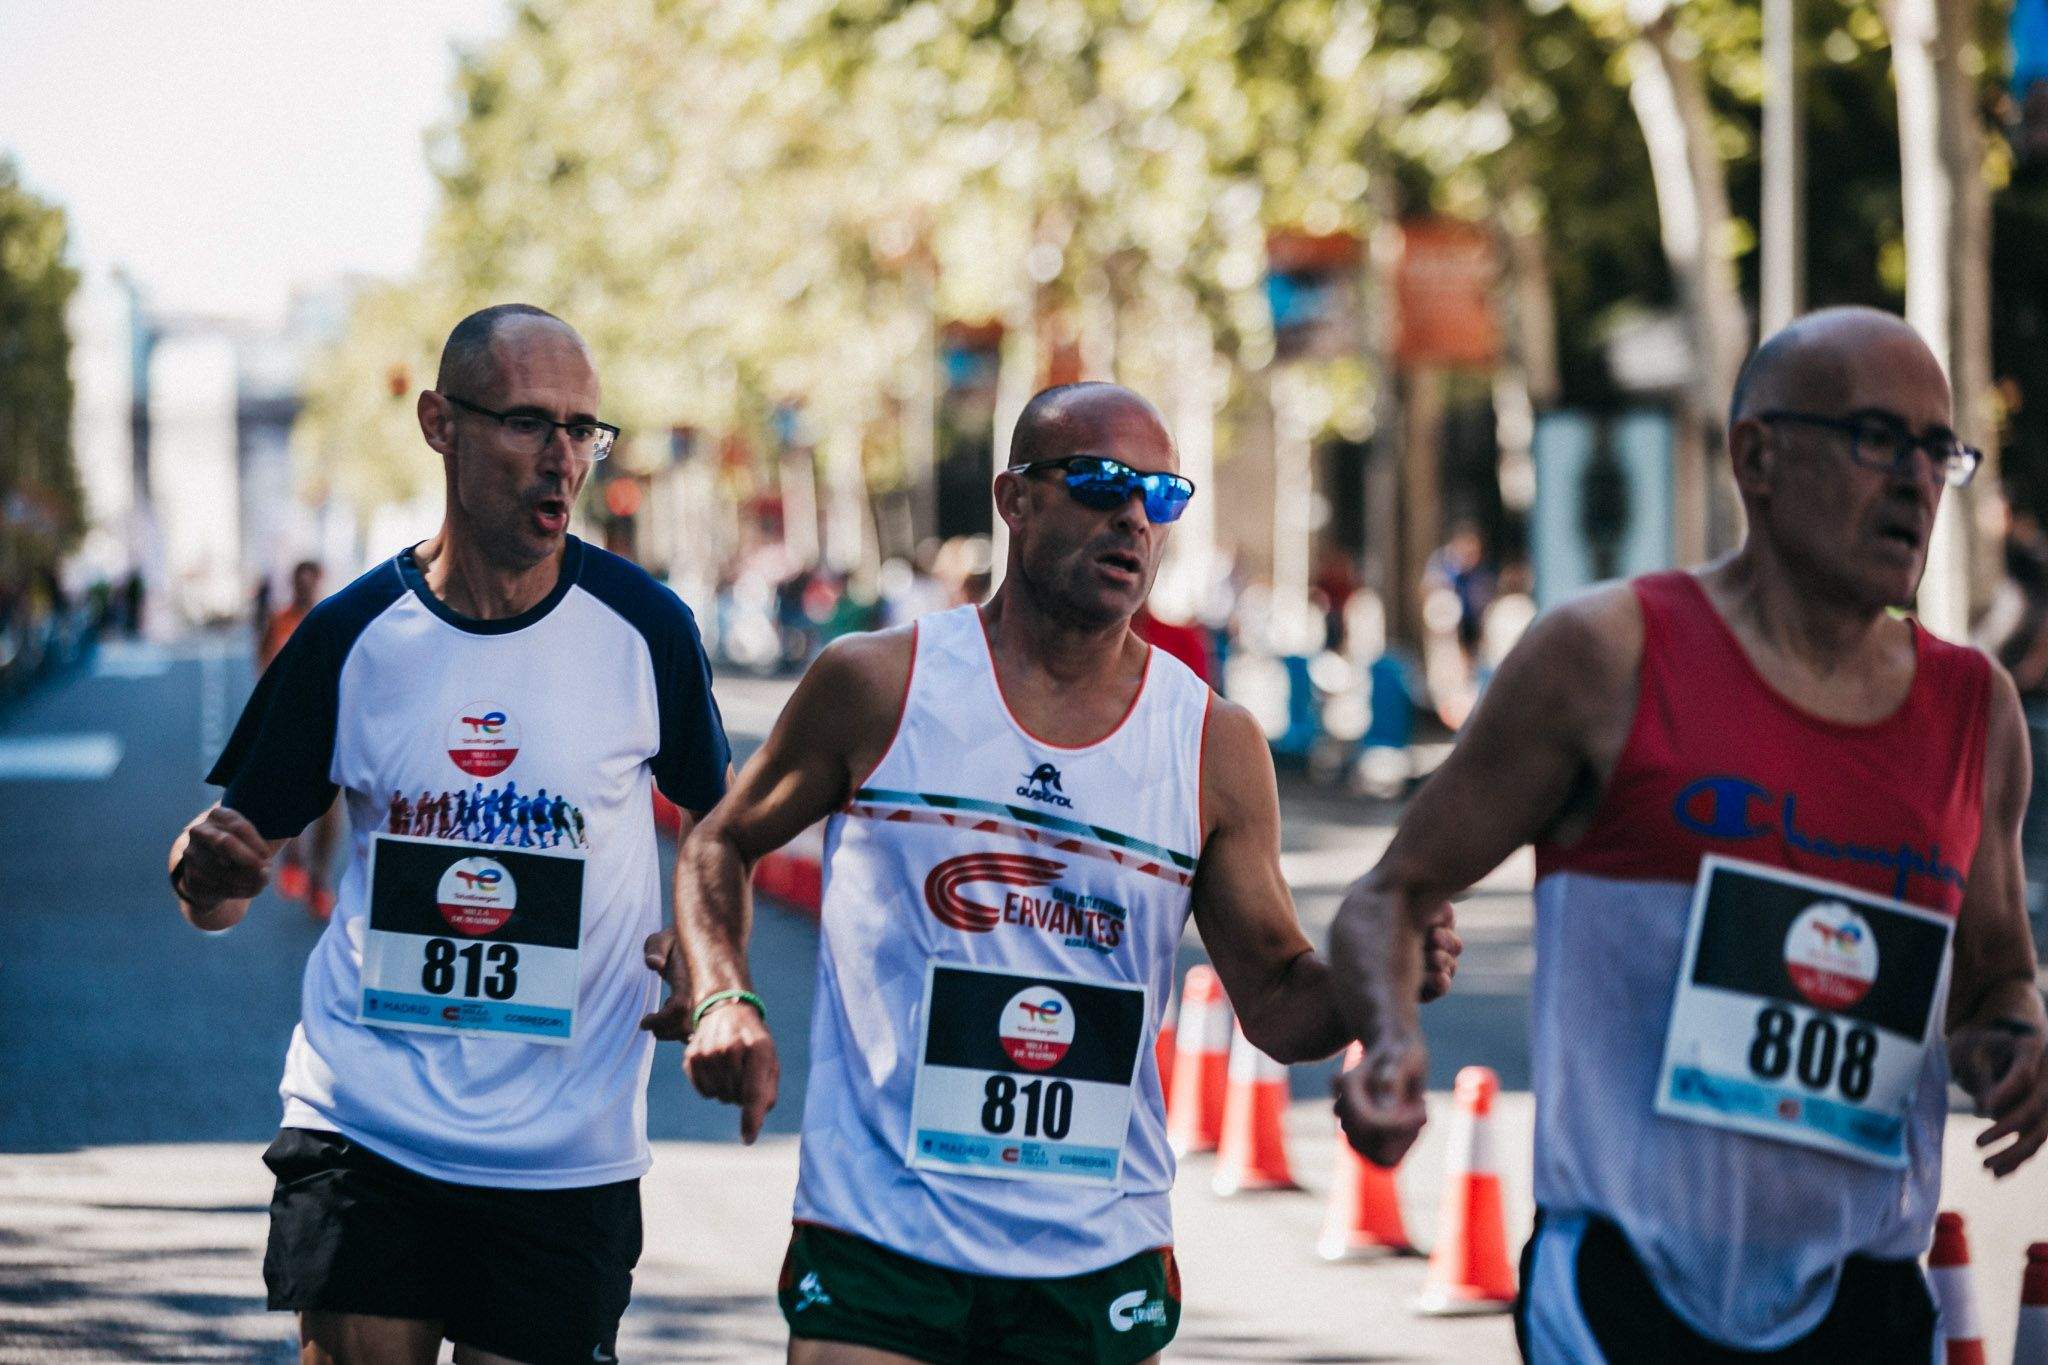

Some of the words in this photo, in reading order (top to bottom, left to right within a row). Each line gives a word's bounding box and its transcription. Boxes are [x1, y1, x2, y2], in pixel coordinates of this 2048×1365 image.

[924, 853, 1125, 947] CERVANTES
[421, 937, 519, 1000] 813
[1749, 1007, 1878, 1102] 808
[981, 1075, 1073, 1140] 810
